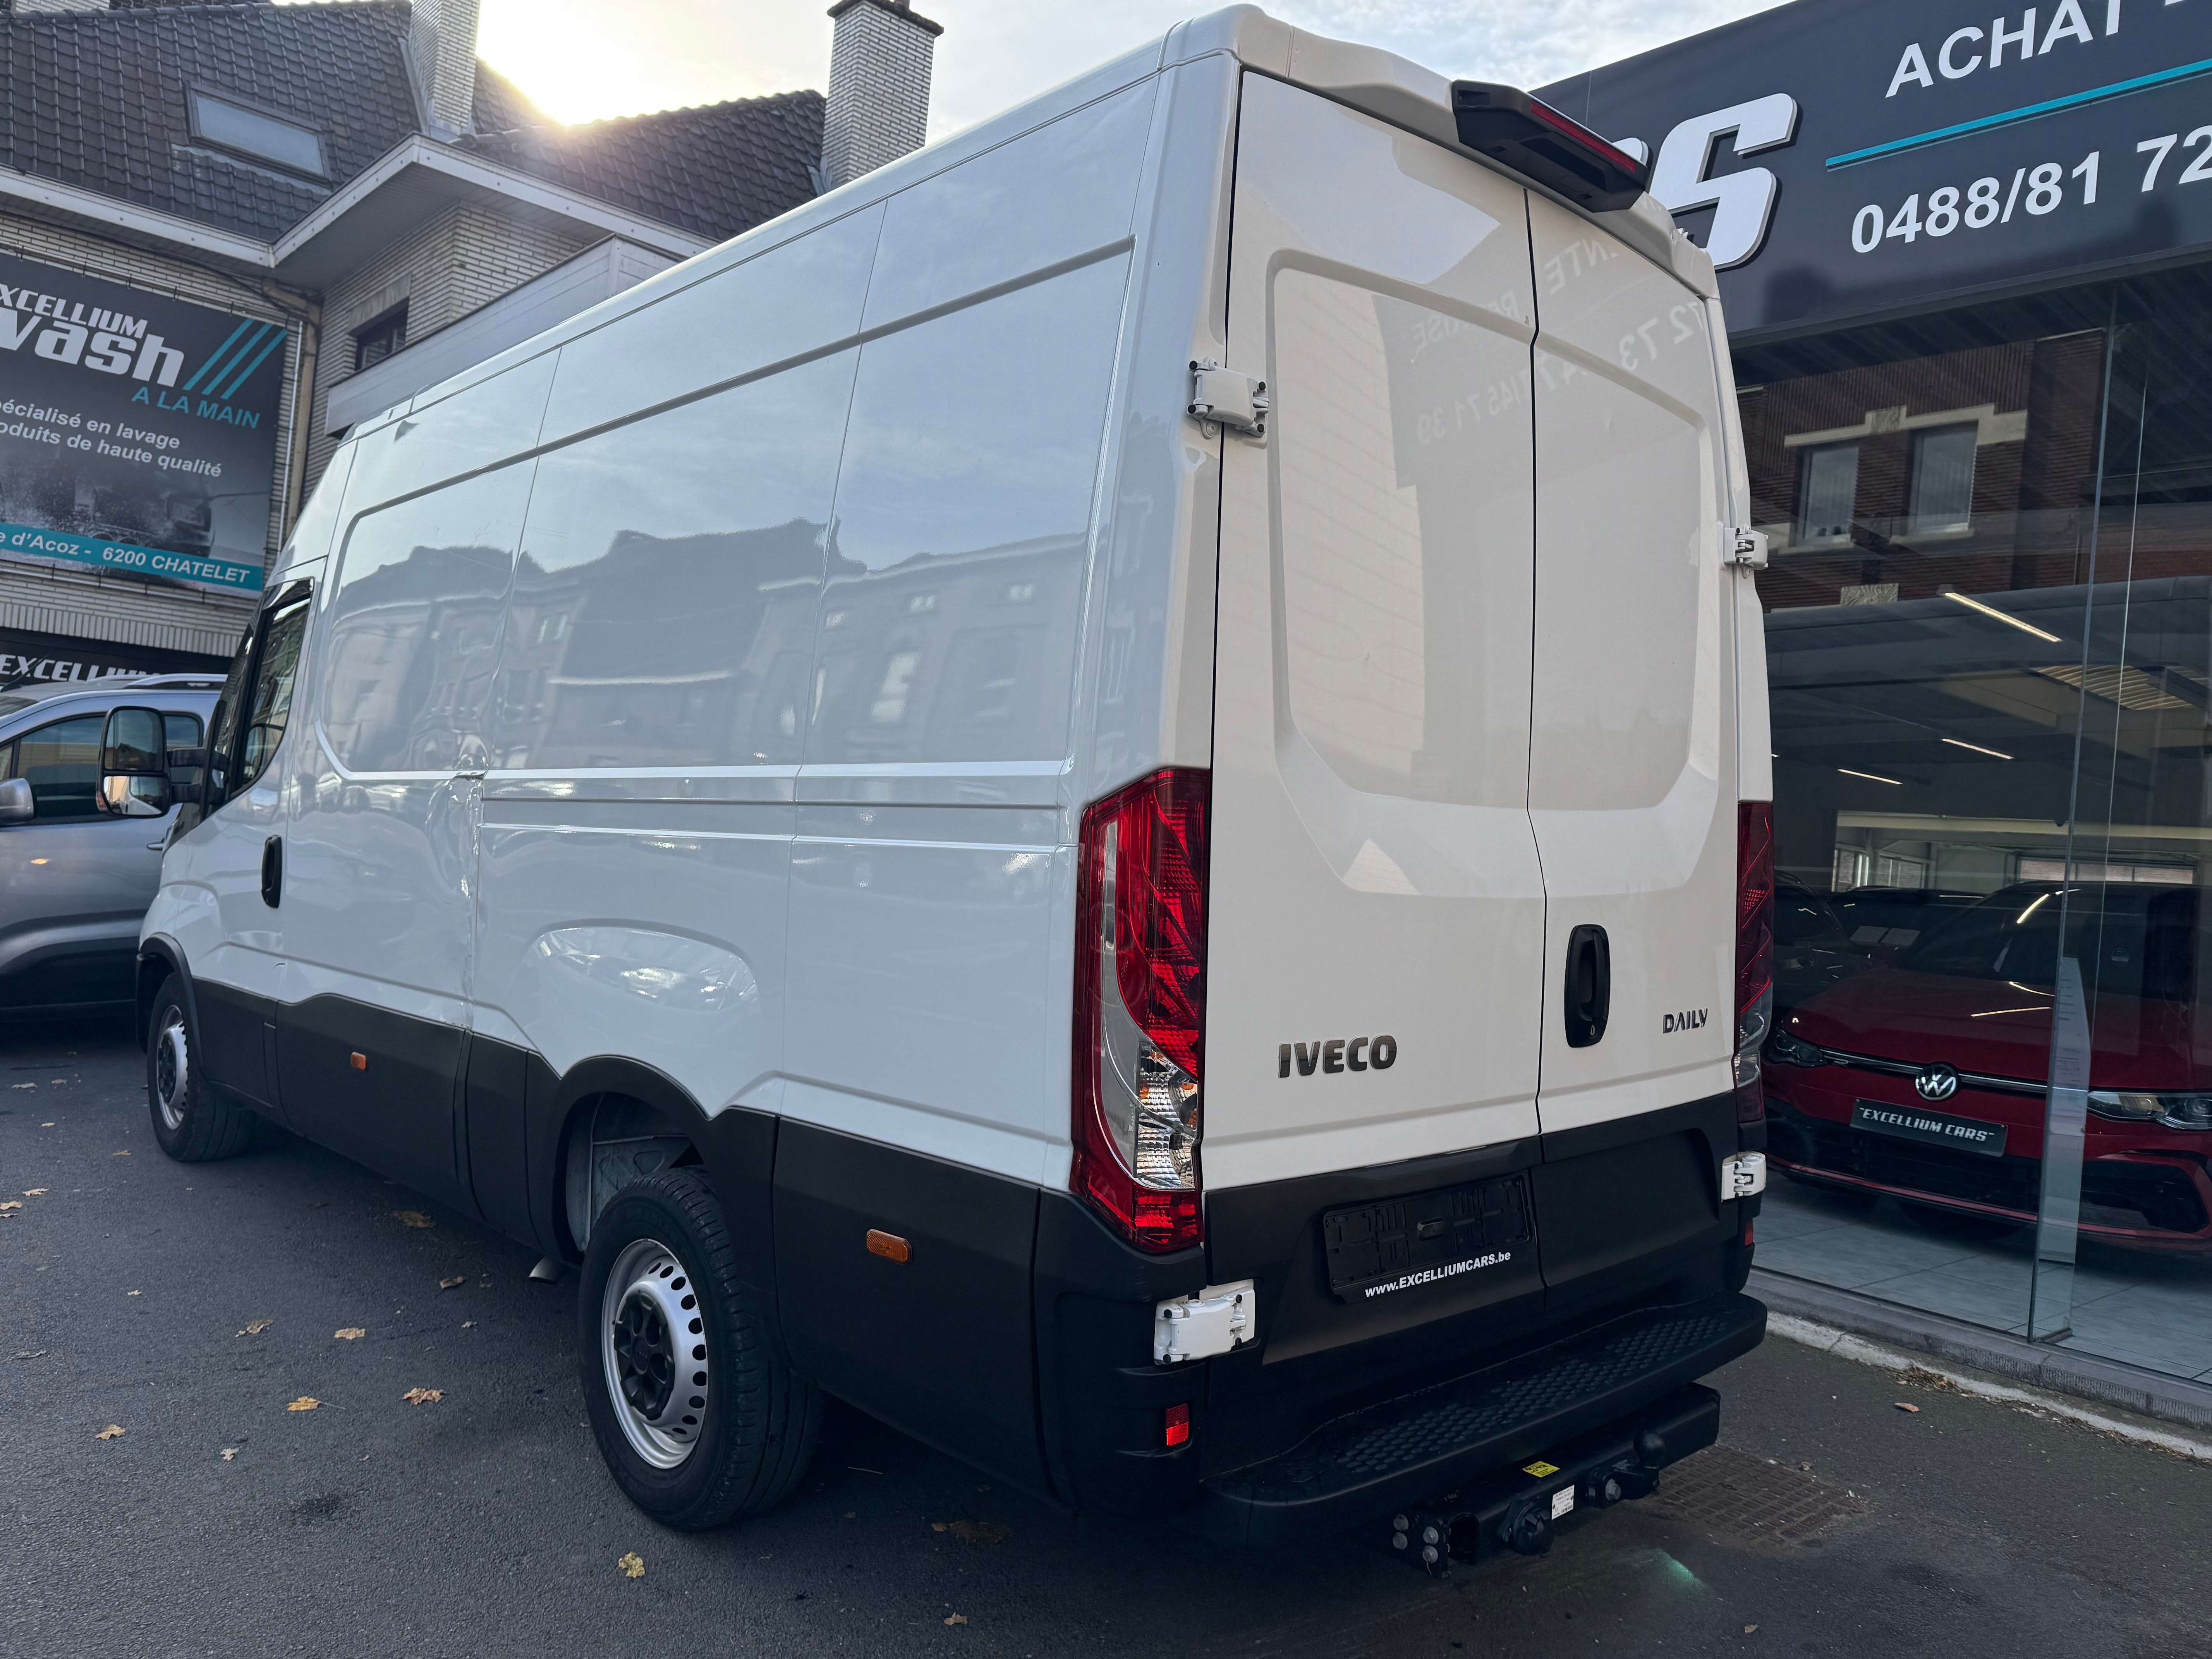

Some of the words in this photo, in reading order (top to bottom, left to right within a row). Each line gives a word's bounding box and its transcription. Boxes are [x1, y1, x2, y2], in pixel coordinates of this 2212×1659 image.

[1851, 151, 2099, 253] 0488/81
[2137, 125, 2212, 192] 72
[0, 399, 81, 428] écialisé
[86, 420, 111, 434] en
[116, 423, 180, 449] lavage
[131, 386, 149, 405] A
[157, 391, 189, 414] LA
[197, 400, 260, 428] MAIN
[67, 434, 91, 450] de
[97, 439, 152, 463] haute
[158, 455, 222, 477] qualité
[103, 546, 146, 566] 6200
[152, 555, 250, 583] CHATELET
[1662, 1008, 1708, 1034] DAILY
[1278, 1035, 1397, 1078] IVECO
[1862, 1108, 1942, 1133] EXCELLIUM
[1365, 1251, 1511, 1298] www.EXCELLIUMCARS.be
